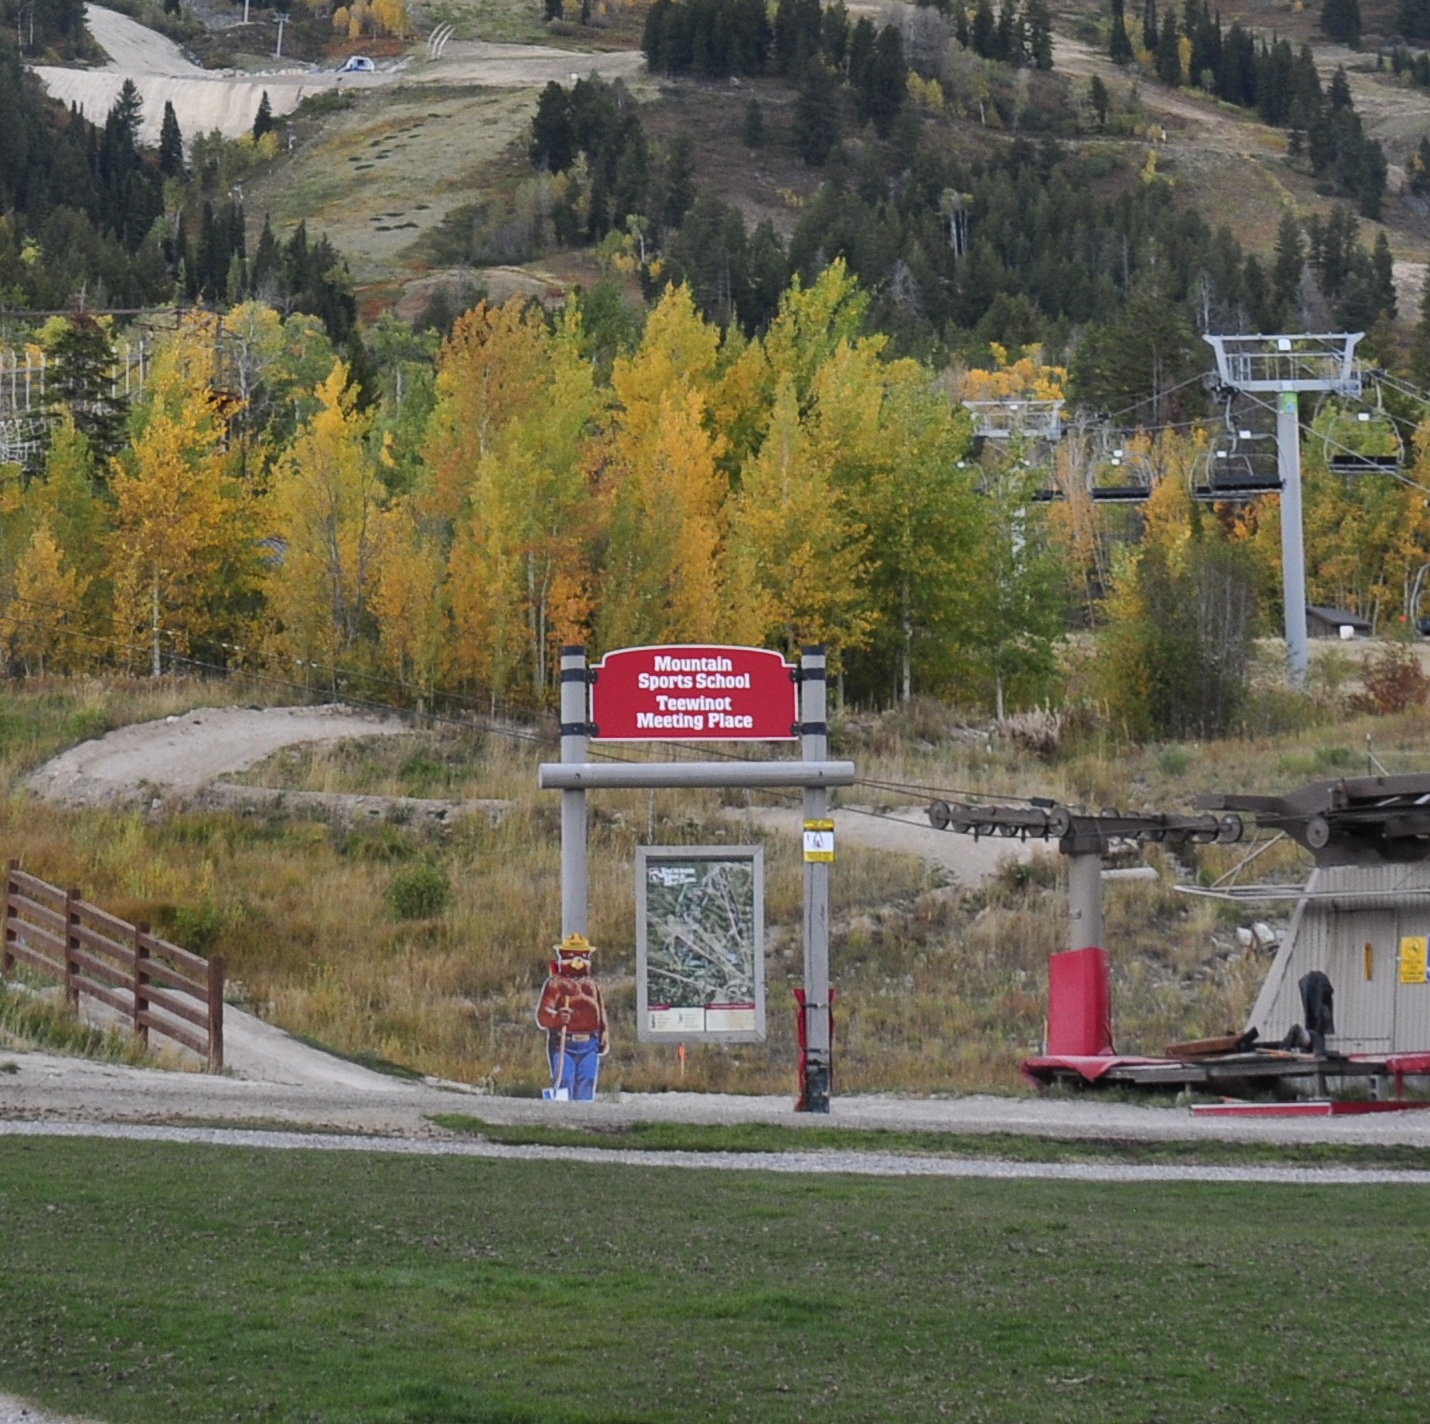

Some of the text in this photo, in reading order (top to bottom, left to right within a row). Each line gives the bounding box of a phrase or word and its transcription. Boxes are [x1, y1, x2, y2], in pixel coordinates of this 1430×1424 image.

[654, 655, 732, 672] Mountain
[638, 673, 750, 691] Sports School
[655, 695, 732, 711] Teewinot
[636, 712, 753, 730] Meeting Place
